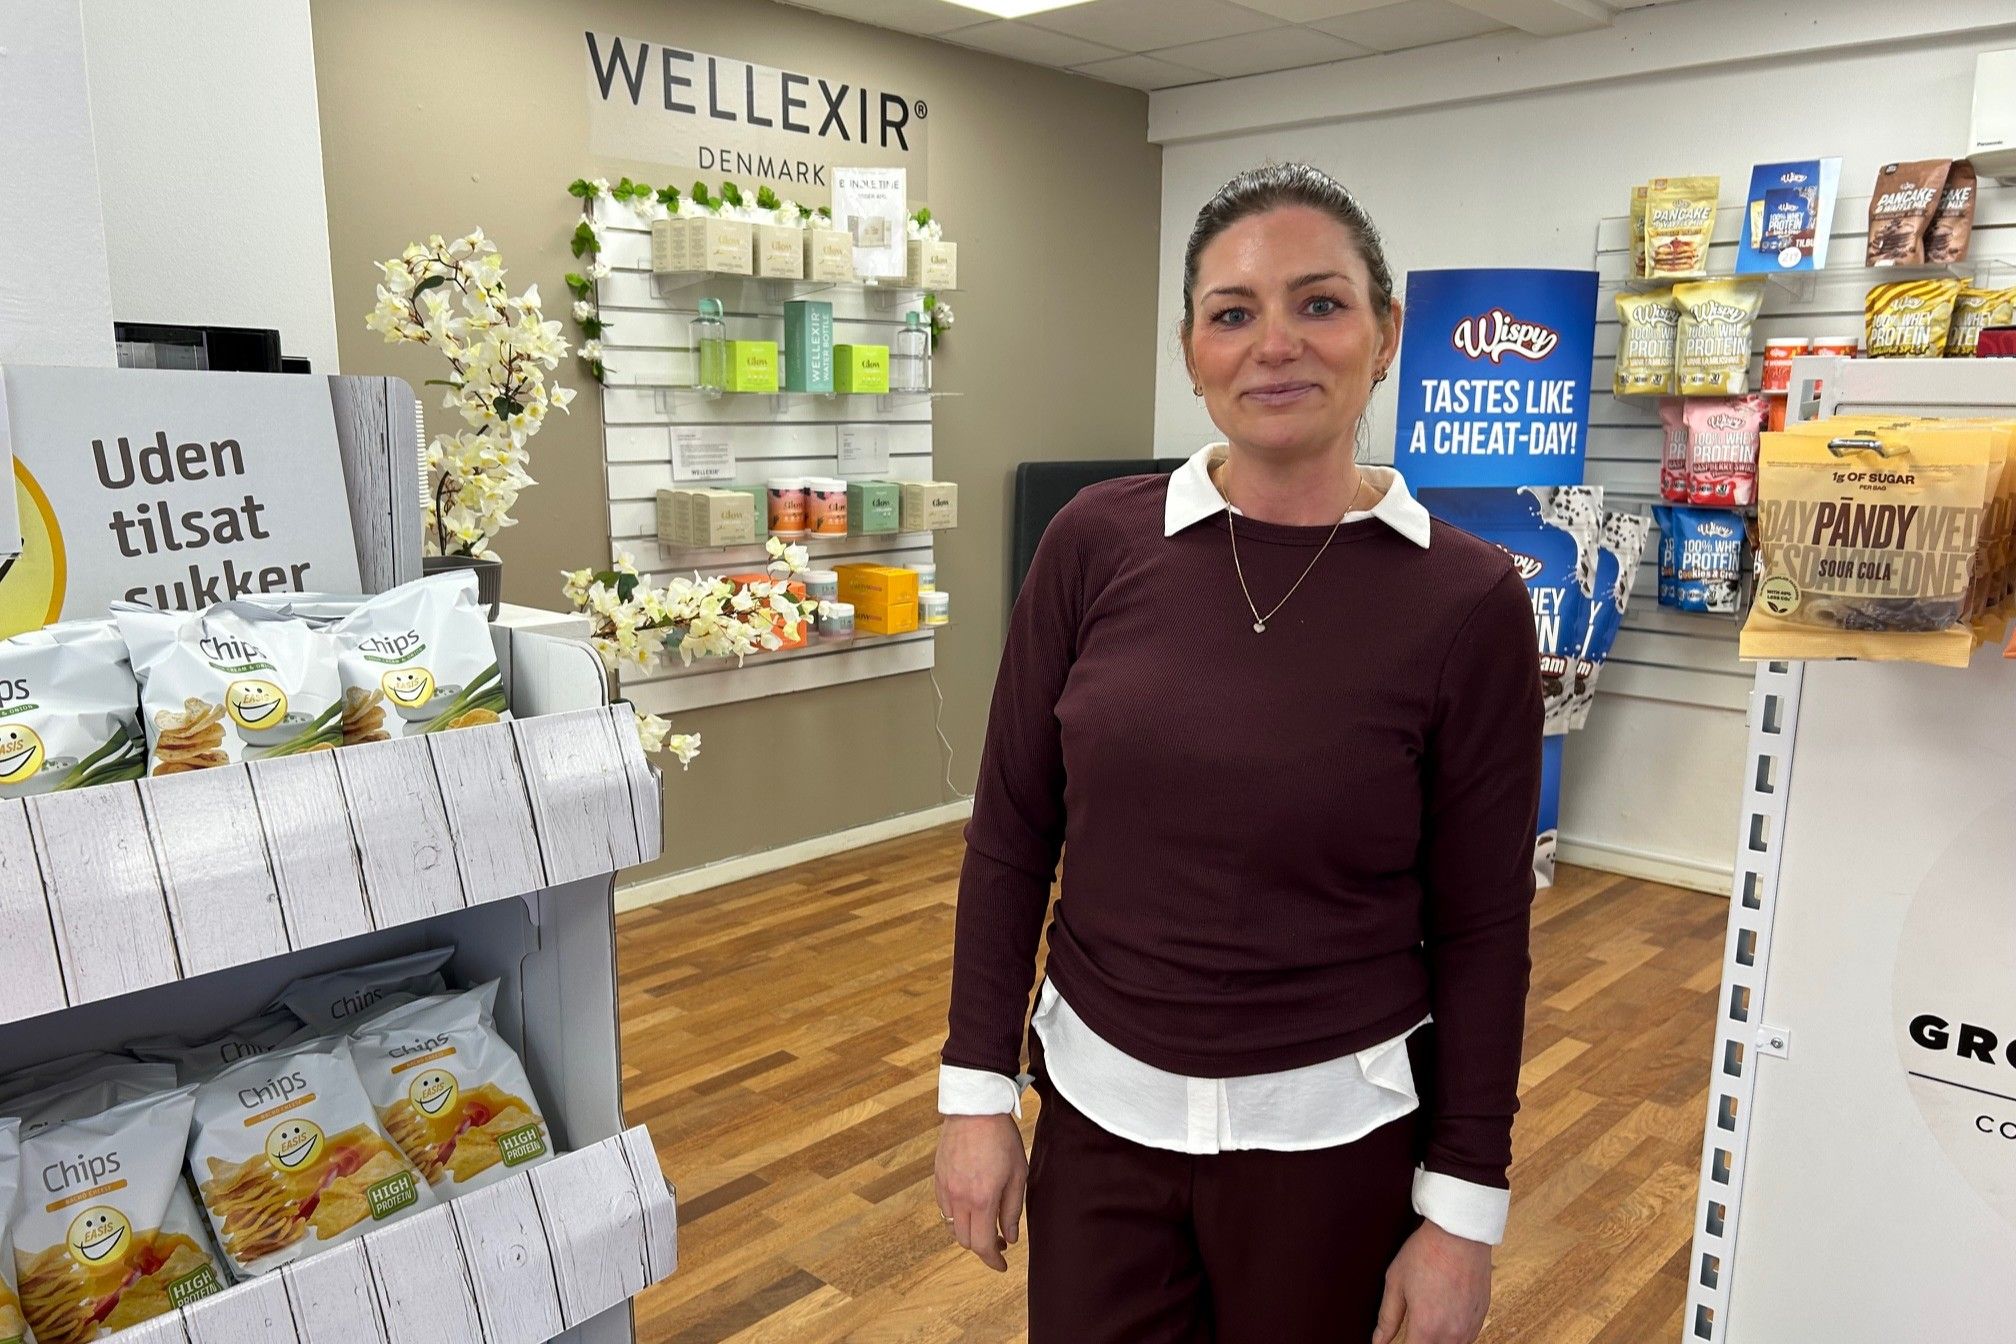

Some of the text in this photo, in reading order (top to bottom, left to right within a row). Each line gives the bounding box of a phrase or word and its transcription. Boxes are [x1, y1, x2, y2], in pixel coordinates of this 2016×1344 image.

[699, 146, 826, 187] DENMARK
[1877, 187, 1937, 206] PANCAKE
[1652, 207, 1712, 222] PANCAKE
[1768, 218, 1804, 232] PROTEIN
[1690, 300, 1746, 325] Wispy
[1901, 311, 1934, 326] WHEY
[1453, 309, 1559, 364] Wispy
[1686, 338, 1747, 356] PROTEIN
[1871, 326, 1931, 347] PROTEIN
[1422, 379, 1575, 414] TASTES LIKE
[1409, 421, 1578, 455] A CHEAT-DAY!
[92, 431, 245, 489] Uden
[1693, 445, 1754, 463] PROTEIN
[1832, 472, 1915, 484] 1g OF SUGAR
[109, 495, 269, 557] tilsat
[1811, 497, 1918, 549] PĀNDY
[1684, 539, 1713, 553] 100%
[1682, 552, 1740, 571] PROTEIN
[1819, 559, 1891, 581] SOUR COLA
[124, 560, 311, 611] sukker
[358, 629, 420, 656] Chips
[9, 703, 34, 715] ONION
[330, 986, 384, 1020] Chips
[389, 1032, 449, 1058] Chips
[1909, 1014, 2016, 1071] GR
[239, 1071, 307, 1109] Chips
[423, 1082, 445, 1099] EASIS
[281, 1132, 308, 1153] EASIS
[502, 1128, 537, 1151] HIGH
[507, 1140, 541, 1161] PROTEIN
[42, 1151, 121, 1193] Chips
[65, 1193, 88, 1205] NACHO
[372, 1177, 410, 1202] HIGH
[376, 1189, 412, 1214] PROTEIN
[84, 1222, 114, 1243] EASIS
[173, 1269, 213, 1299] HIGH
[178, 1282, 218, 1308] PROTEIN
